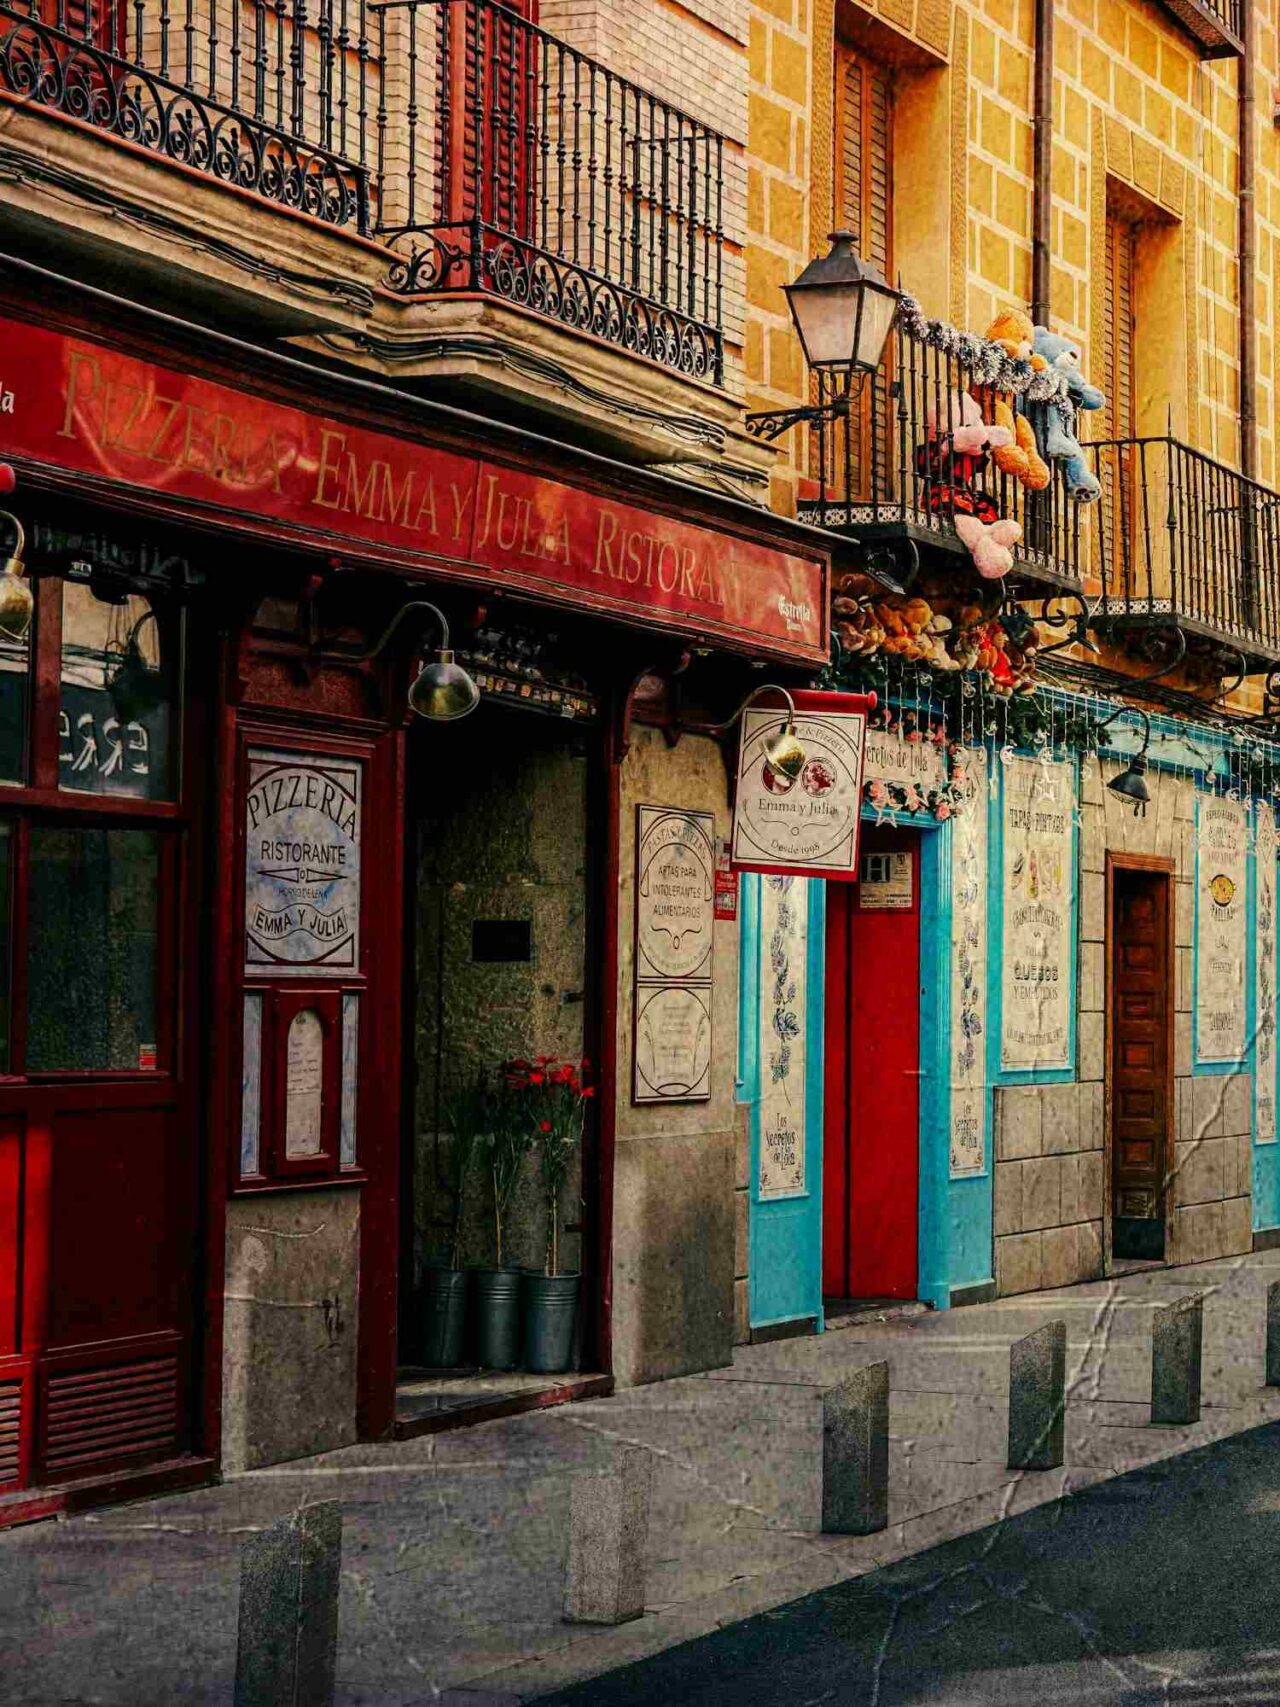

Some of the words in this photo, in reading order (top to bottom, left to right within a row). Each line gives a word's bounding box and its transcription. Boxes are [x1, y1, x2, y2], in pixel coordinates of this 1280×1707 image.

[57, 351, 284, 495] PIZZERIA
[312, 429, 440, 535] EMMA
[450, 483, 473, 542] Y
[477, 474, 572, 567] JULIA
[247, 775, 357, 841] PIZZERIA
[758, 799, 796, 812] Emma
[809, 801, 838, 817] Julia
[261, 841, 346, 865] RISTORANTE
[771, 839, 798, 854] Desde
[801, 842, 820, 855] 1998
[255, 912, 292, 934] EMMA
[297, 909, 306, 926] Y
[310, 914, 345, 937] JULIA
